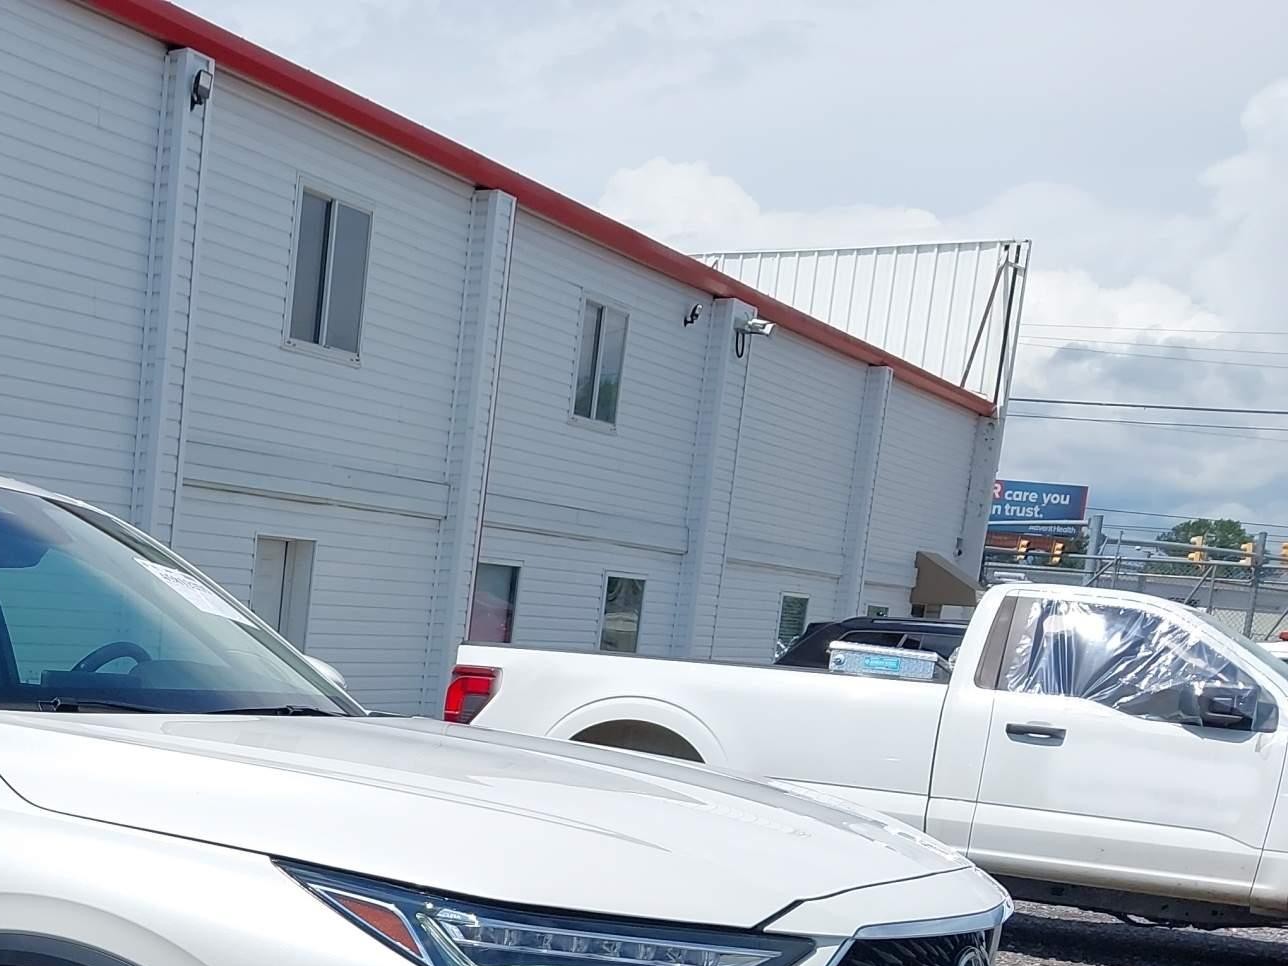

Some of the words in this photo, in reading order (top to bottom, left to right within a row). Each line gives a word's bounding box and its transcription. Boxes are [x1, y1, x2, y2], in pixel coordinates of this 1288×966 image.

[1004, 490, 1038, 502] care
[1043, 492, 1070, 506] you
[1004, 504, 1043, 518] trust.
